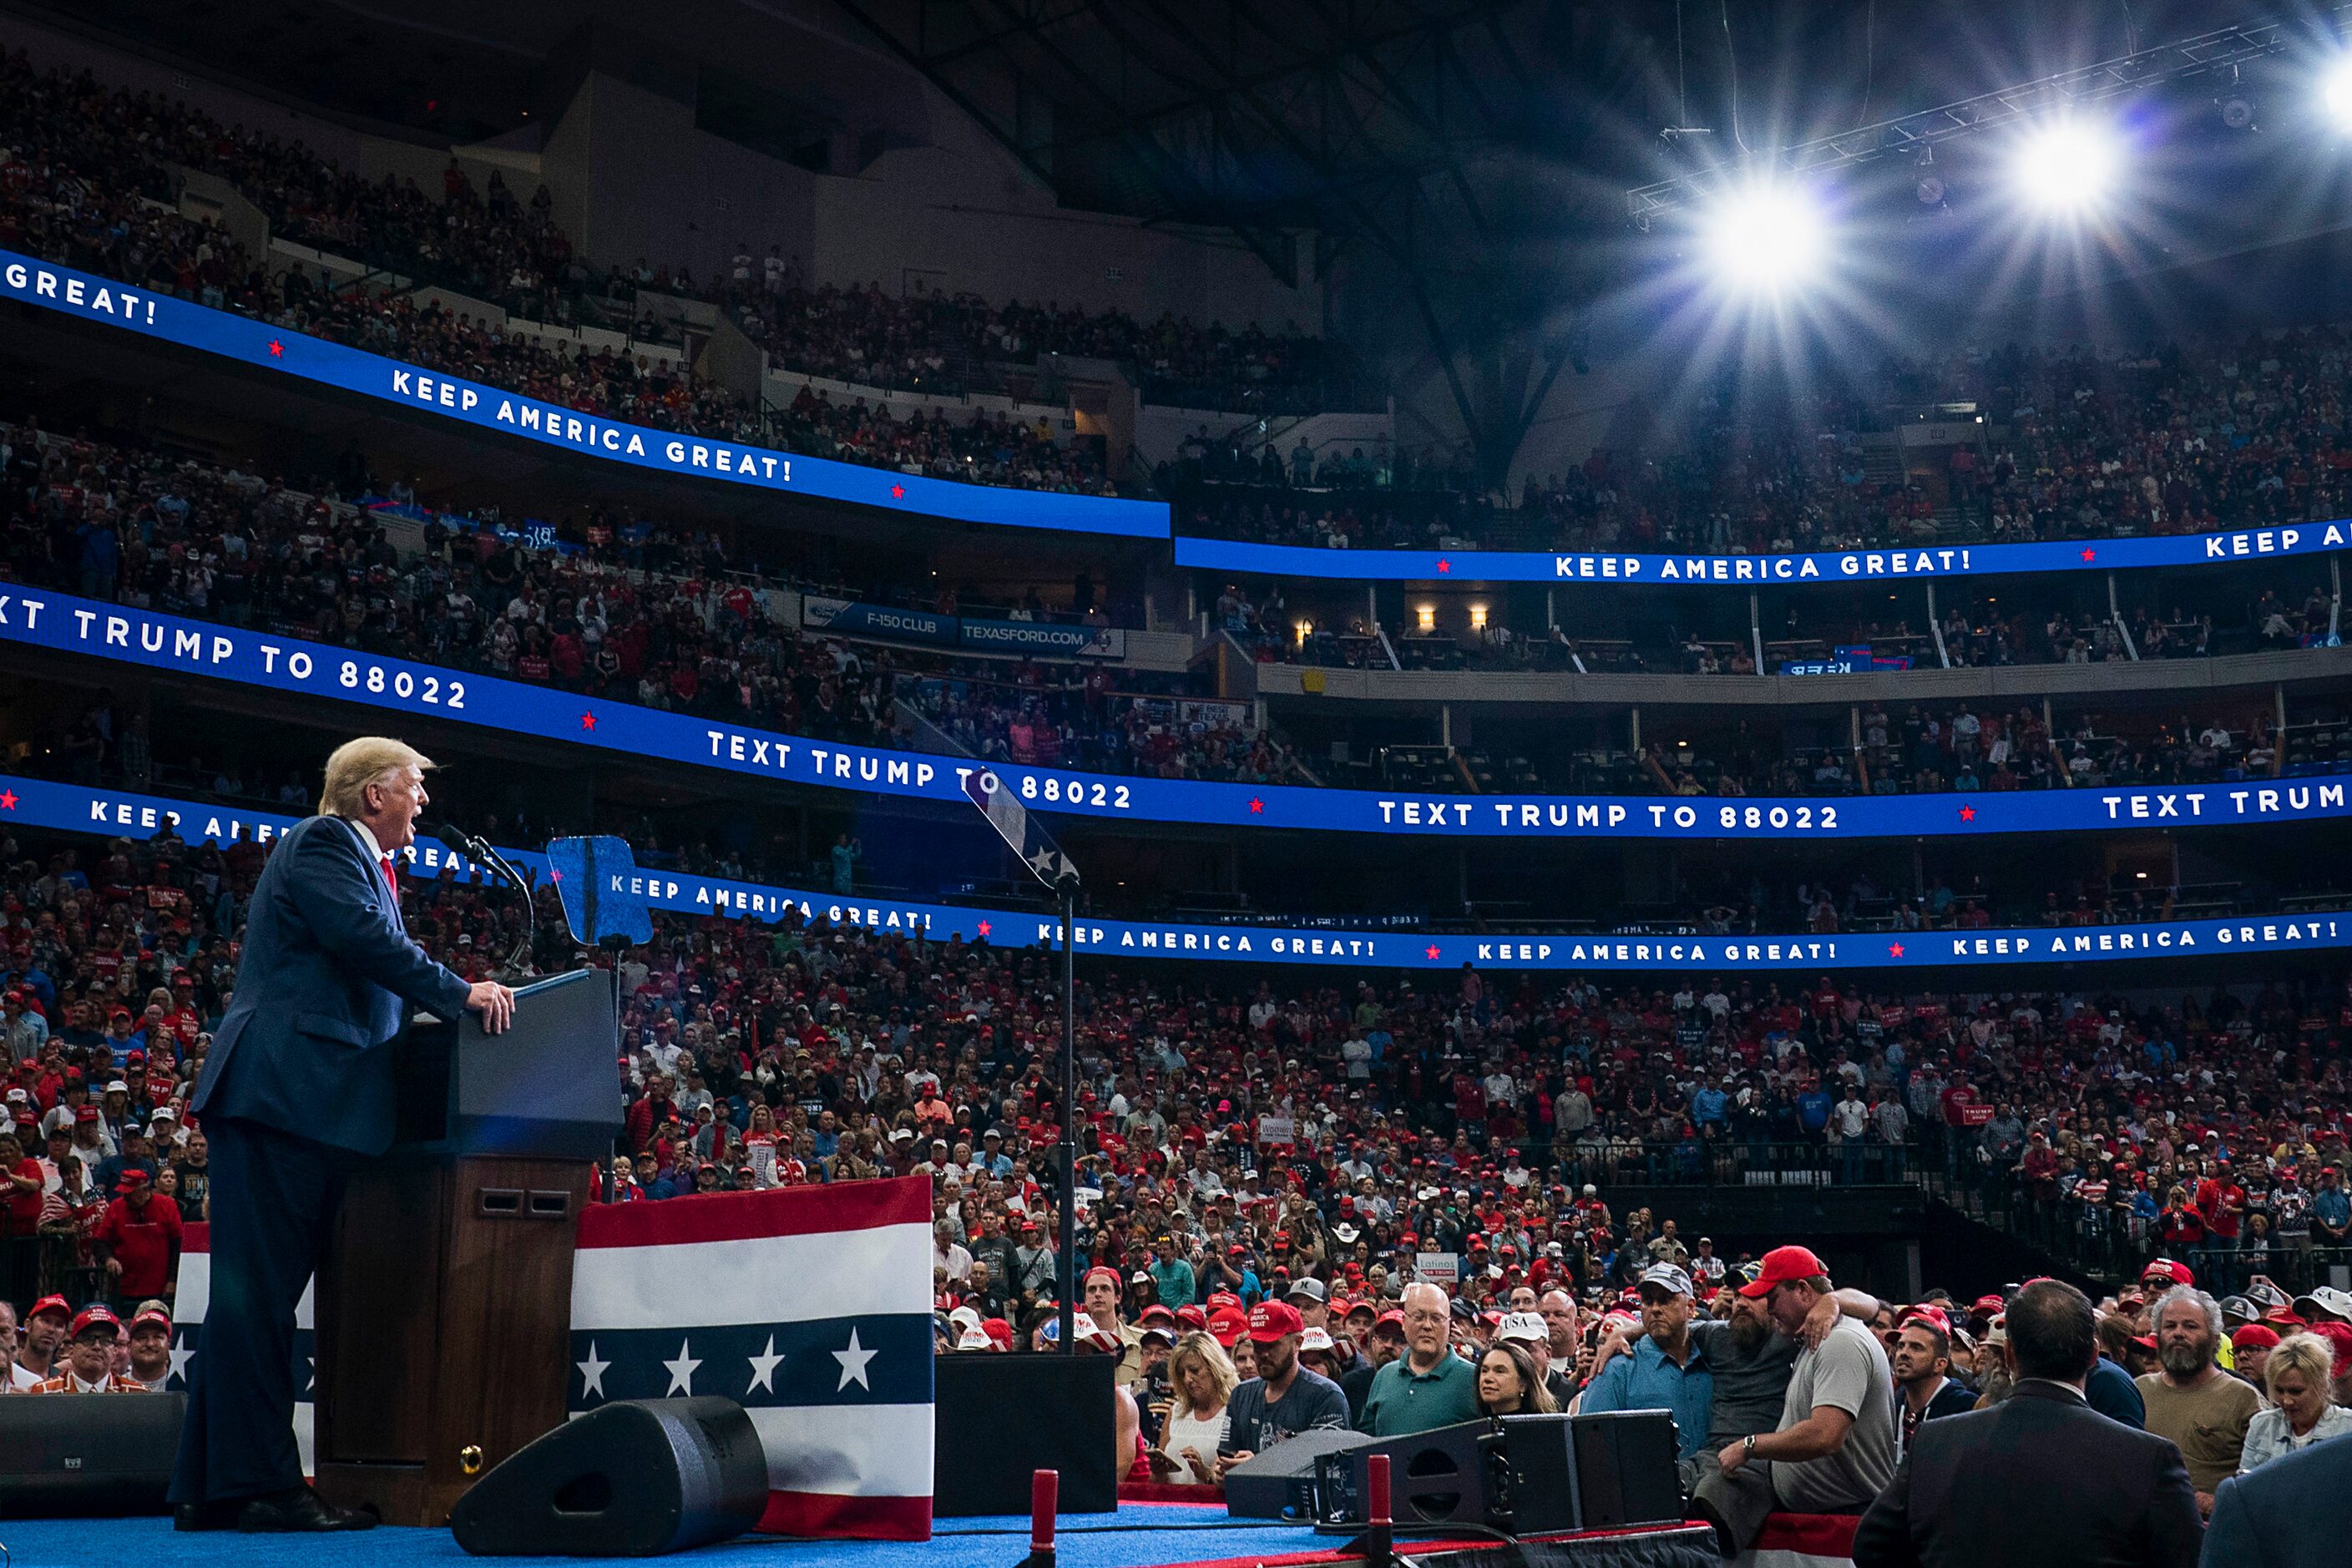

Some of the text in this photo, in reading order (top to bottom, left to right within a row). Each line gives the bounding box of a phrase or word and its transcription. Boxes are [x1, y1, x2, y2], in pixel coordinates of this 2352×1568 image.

[7, 265, 155, 325] GREAT!
[394, 370, 791, 482] KEEP AMERICA GREAT!
[2207, 524, 2352, 558] KEEP A
[1556, 551, 1970, 579] KEEP AMERICA GREAT!
[867, 612, 937, 634] F-150 CLUB
[964, 625, 1084, 645] TEXASFORD.COM
[75, 610, 233, 664] TRUMP
[261, 645, 312, 679] TO
[340, 661, 465, 709] 88022
[708, 731, 1130, 808] TEXT TRUMP TO 88022
[1379, 802, 1837, 828] TEXT TRUMP TO 88022
[2103, 785, 2344, 818] TEXT TRUM
[612, 876, 931, 930] KEEP AMERICA GREAT!
[1121, 932, 1252, 952] AMERICA
[1272, 938, 1374, 957] GREAT!
[1479, 943, 1835, 960] KEEP AMERICA GREAT!
[1954, 923, 2337, 955] KEEP AMERICA GREAT!
[146, 1083, 169, 1094] MP
[1420, 1259, 1455, 1268] Latinos
[963, 1331, 984, 1339] TRUMP
[1505, 1317, 1529, 1330] USA
